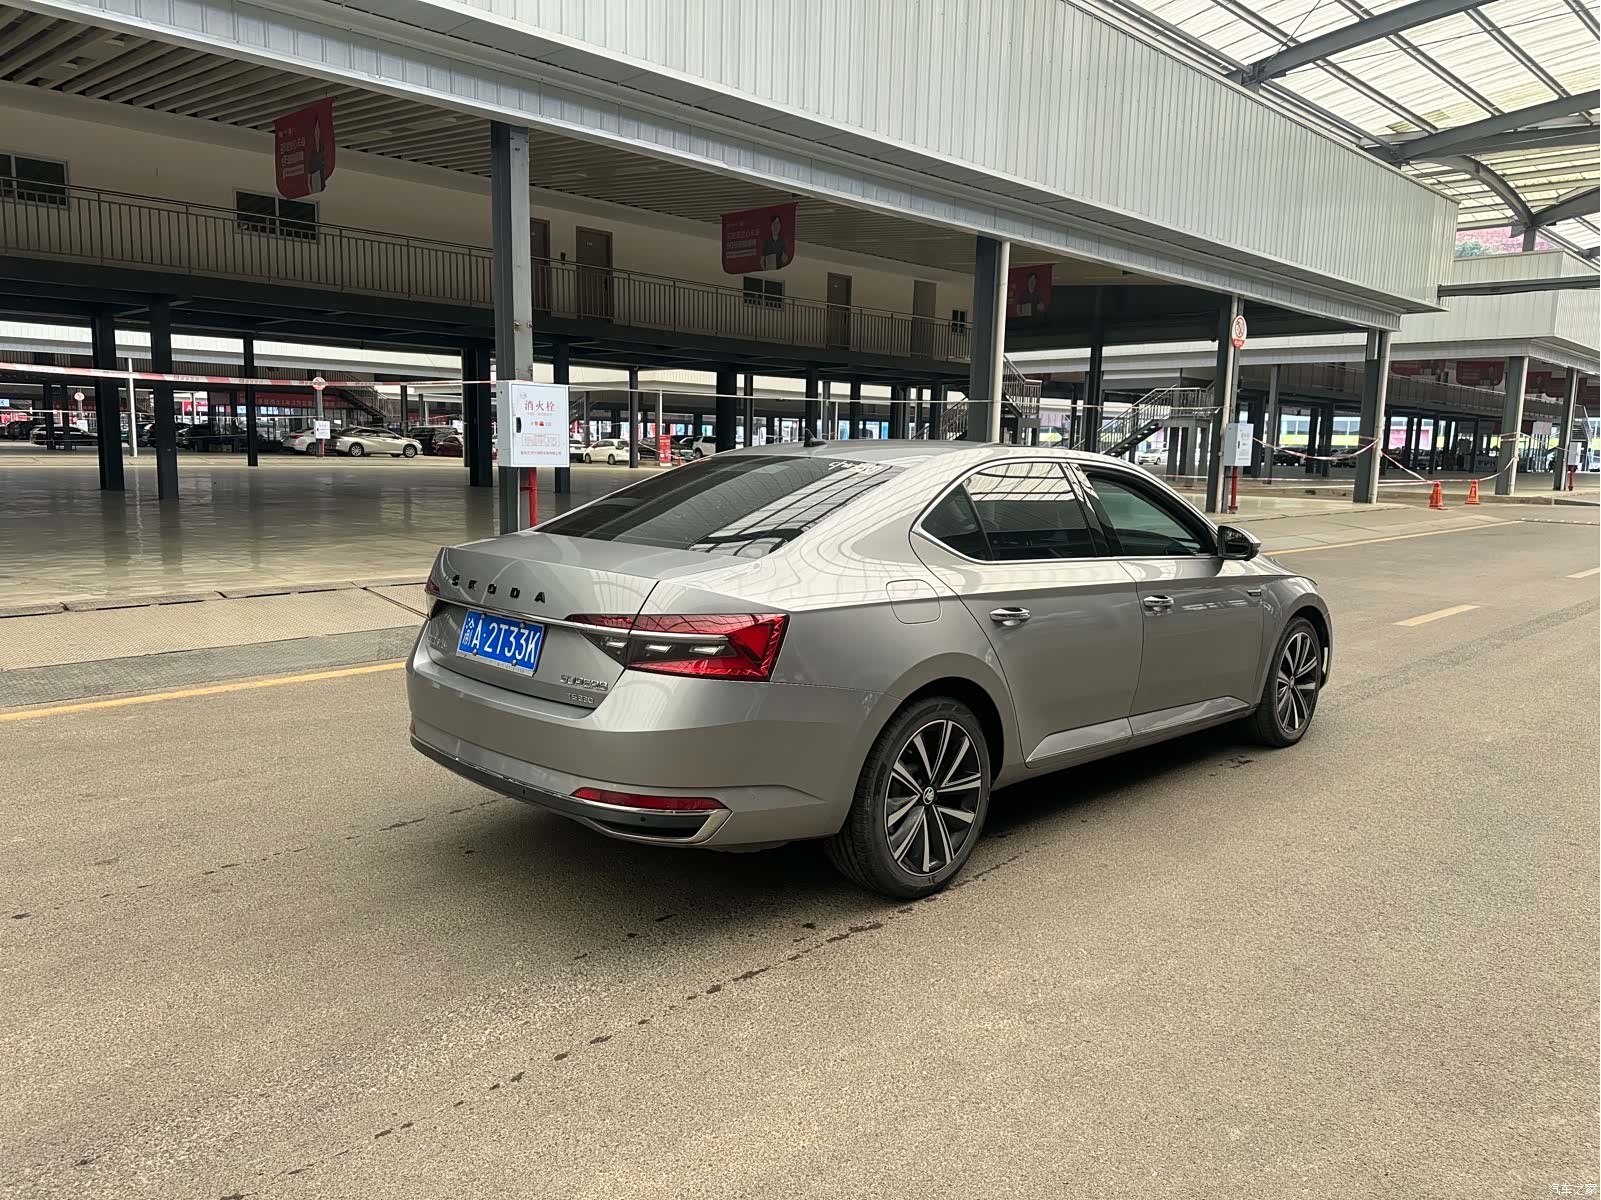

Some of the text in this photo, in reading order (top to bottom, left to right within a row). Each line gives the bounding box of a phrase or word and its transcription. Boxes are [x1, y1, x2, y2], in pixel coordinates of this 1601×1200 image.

[524, 399, 555, 412] 消火栓
[452, 575, 546, 604] SKODA
[560, 674, 608, 691] SUPERB
